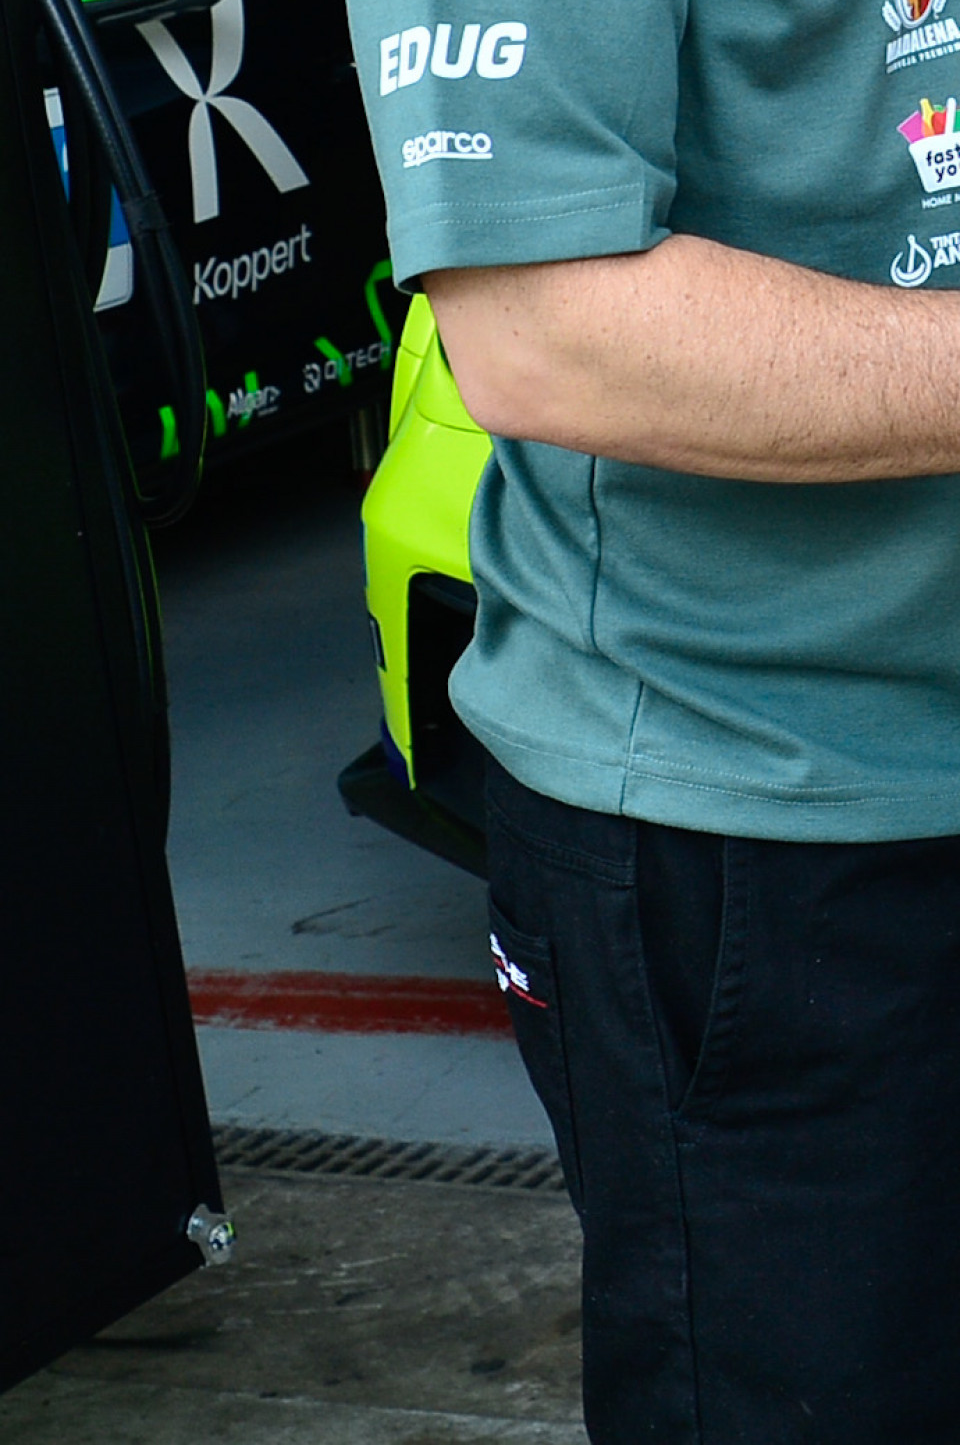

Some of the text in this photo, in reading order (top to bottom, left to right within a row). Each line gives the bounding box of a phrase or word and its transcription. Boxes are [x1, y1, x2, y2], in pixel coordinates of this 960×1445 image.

[379, 21, 528, 96] EDUG
[401, 130, 493, 167] sparco
[921, 193, 953, 209] HOME
[192, 223, 313, 306] Koppert
